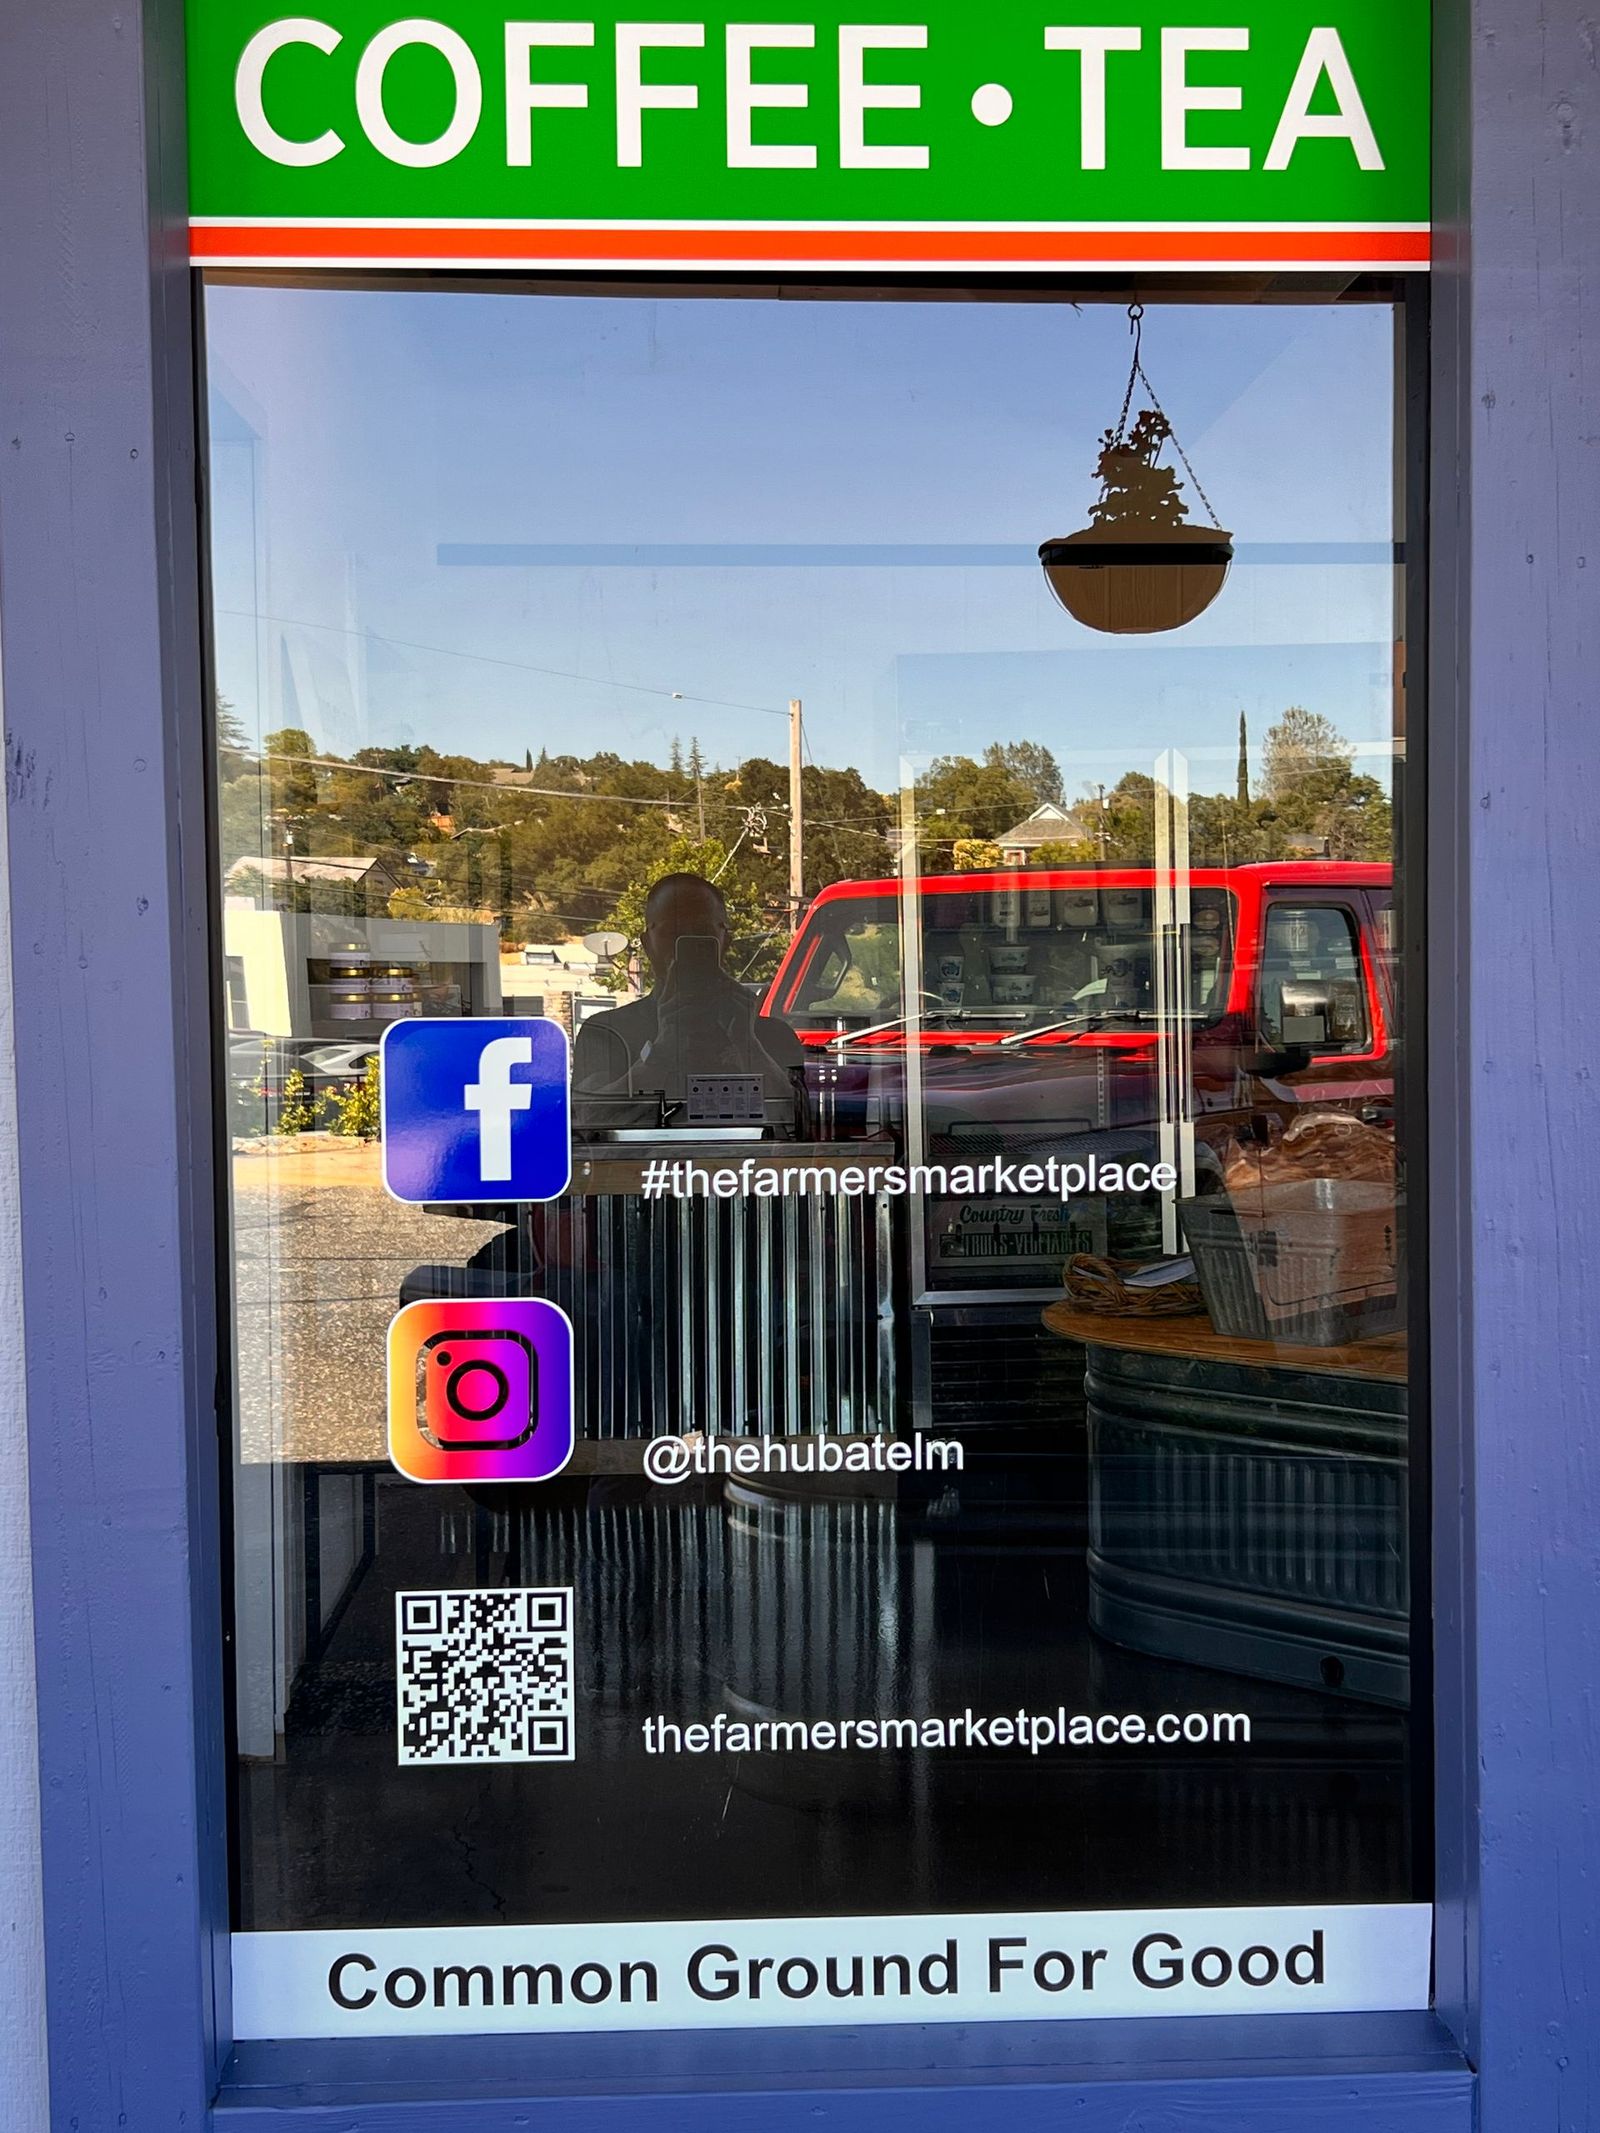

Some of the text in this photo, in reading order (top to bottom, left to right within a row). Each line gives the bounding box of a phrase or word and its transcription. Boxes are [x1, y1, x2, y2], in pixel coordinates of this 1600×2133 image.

[235, 17, 1386, 170] COFFEE TEA
[640, 1154, 1178, 1201] #thefarmersmarketplace
[959, 1204, 1025, 1225] Country
[642, 1432, 965, 1485] @thehubatelm
[642, 1707, 1252, 1755] thefarmersmarketplace.com
[327, 1929, 1325, 2010] Common Ground For Good
